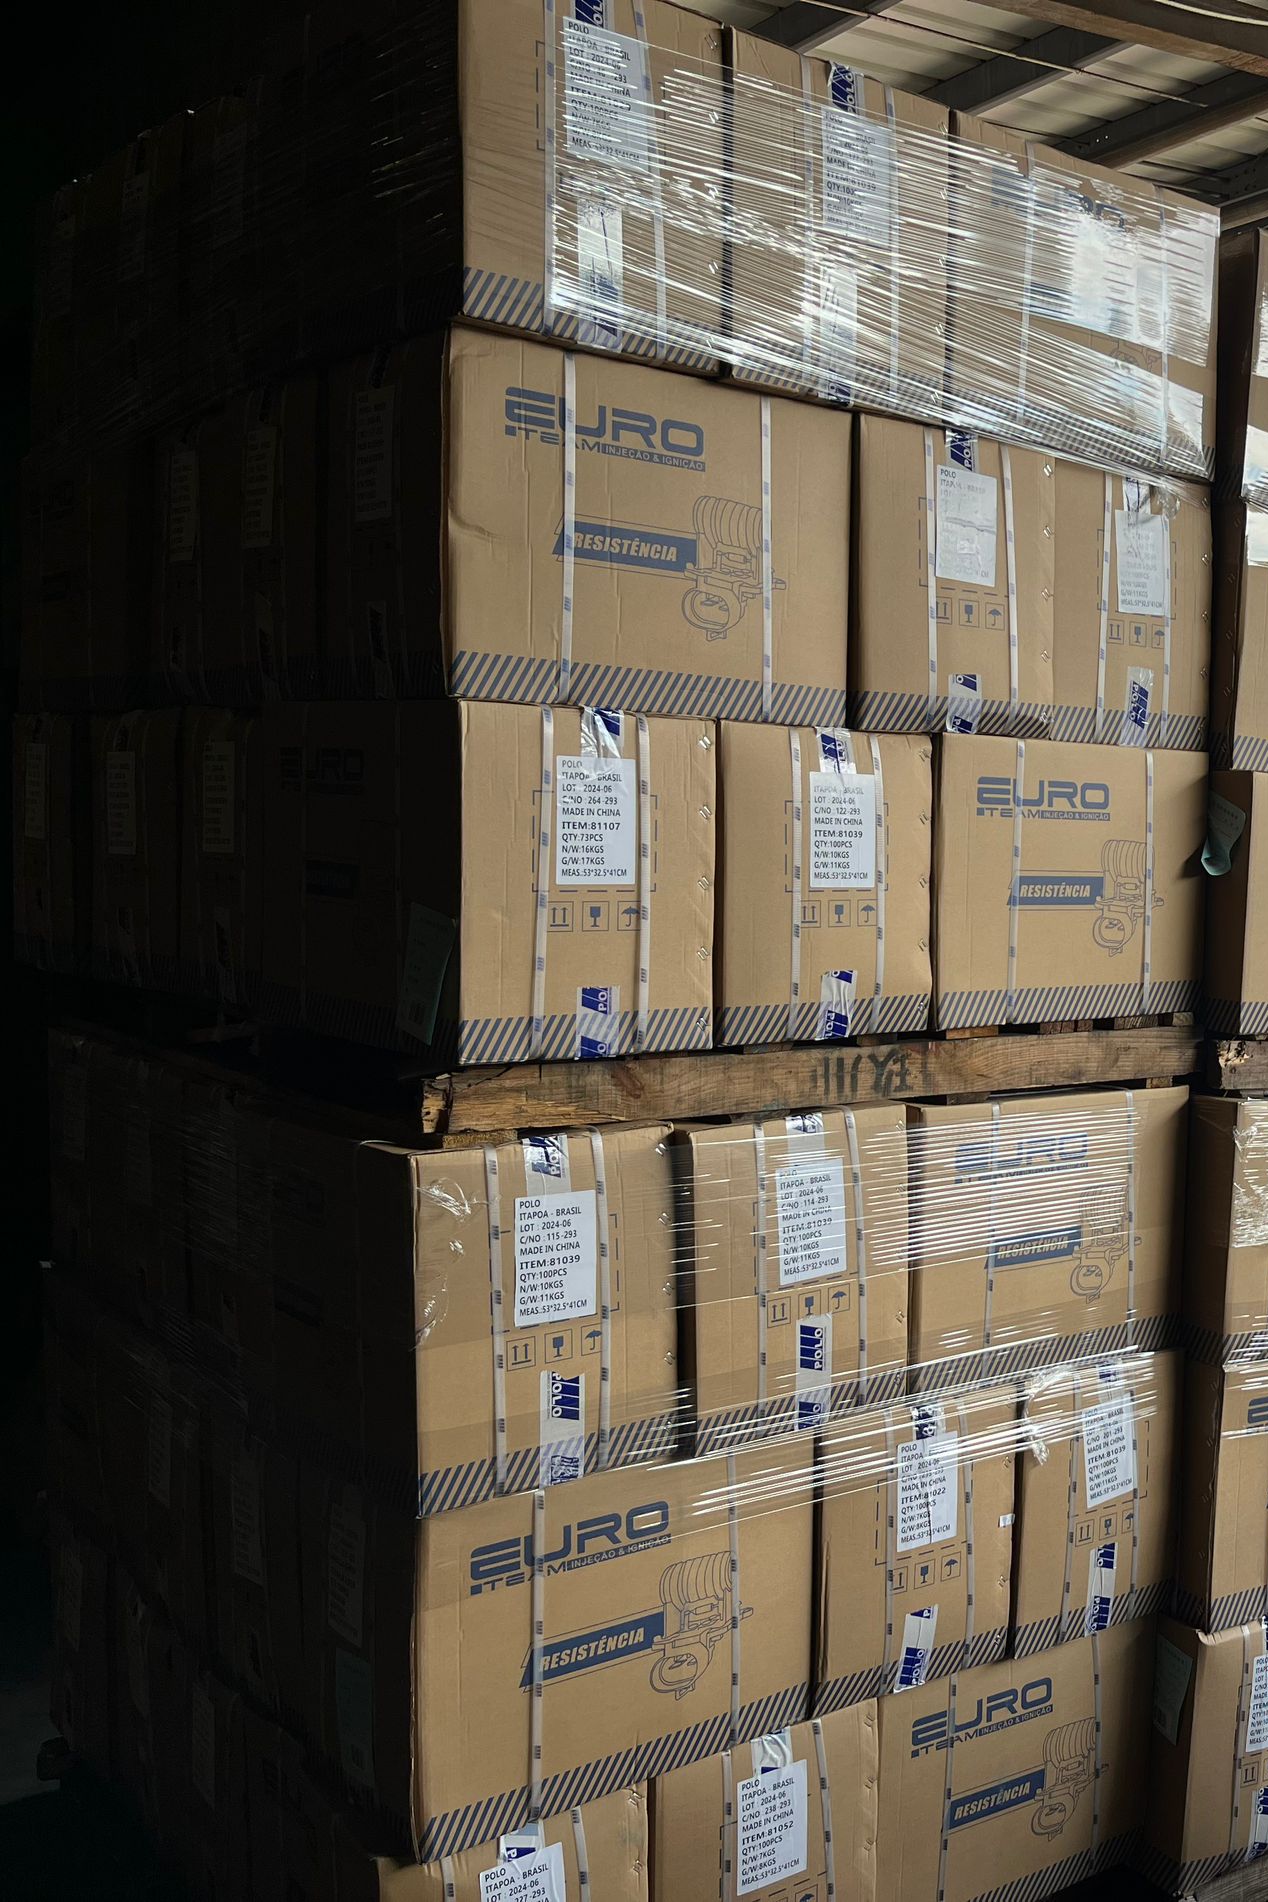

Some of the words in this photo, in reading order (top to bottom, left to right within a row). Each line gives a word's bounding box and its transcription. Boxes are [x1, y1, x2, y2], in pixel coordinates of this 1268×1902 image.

[505, 386, 704, 457] EURO
[574, 532, 677, 561] RESISTÊNCIA
[598, 773, 622, 782] BRASIL
[563, 784, 575, 792] LOT
[977, 776, 1109, 809] EURO
[562, 822, 620, 830] ITEM:81107
[562, 834, 603, 842] QTY:73PCS
[815, 830, 863, 838] ITEM:81039
[814, 841, 852, 849] QTY:100PCS
[562, 857, 604, 865] G/W:17KGS
[1020, 882, 1090, 897] RESISTÊNCIA
[781, 1180, 804, 1190] ITAPOA
[810, 1176, 831, 1185] BRASIL
[800, 1187, 823, 1197] 2024-06
[520, 1200, 540, 1209] POLO
[520, 1212, 548, 1221] ITAPOA
[556, 1207, 581, 1216] BRASIL
[520, 1224, 535, 1232] LOT
[542, 1220, 571, 1230] 2024-06
[520, 1235, 541, 1244] C/NO
[520, 1246, 543, 1256] MADE
[545, 1245, 553, 1253] IN
[556, 1241, 580, 1251] CHINA
[520, 1255, 580, 1270] ITEM:81039
[520, 1268, 567, 1282] QTY:100PCS
[520, 1281, 563, 1293] N/W:10KGS
[520, 1292, 564, 1305] G/W:11KGS
[814, 1329, 822, 1369] POLO
[552, 1373, 562, 1417] POLO
[902, 1444, 917, 1452] POLO
[1088, 1443, 1101, 1454] MADE
[902, 1483, 919, 1492] MADE
[471, 1501, 669, 1580] EURO
[540, 1627, 644, 1672] RESISTÊNCIA
[912, 1677, 1052, 1746] EURO
[742, 1780, 759, 1791] POLO
[742, 1788, 766, 1801] ITAPOA
[773, 1778, 794, 1790] BRASIL
[742, 1802, 754, 1812] LOT
[761, 1791, 786, 1805] 2024-06
[955, 1782, 1031, 1820] RESISTÊNCIA
[742, 1811, 760, 1823] C/NO
[765, 1800, 791, 1815] 238-293
[742, 1820, 762, 1832] MADE
[764, 1817, 771, 1826] IN
[773, 1809, 793, 1822] CHINA
[742, 1821, 794, 1845] ITEM:81052
[742, 1835, 782, 1856] QTY:100PCS
[742, 1849, 775, 1865] N/W:7KGS
[742, 1858, 776, 1875] G/W:8KGS
[485, 1868, 506, 1881] POLO
[486, 1877, 515, 1893] ITAPOA
[522, 1864, 548, 1879] BRASIL
[509, 1878, 539, 1896] 2024-06
